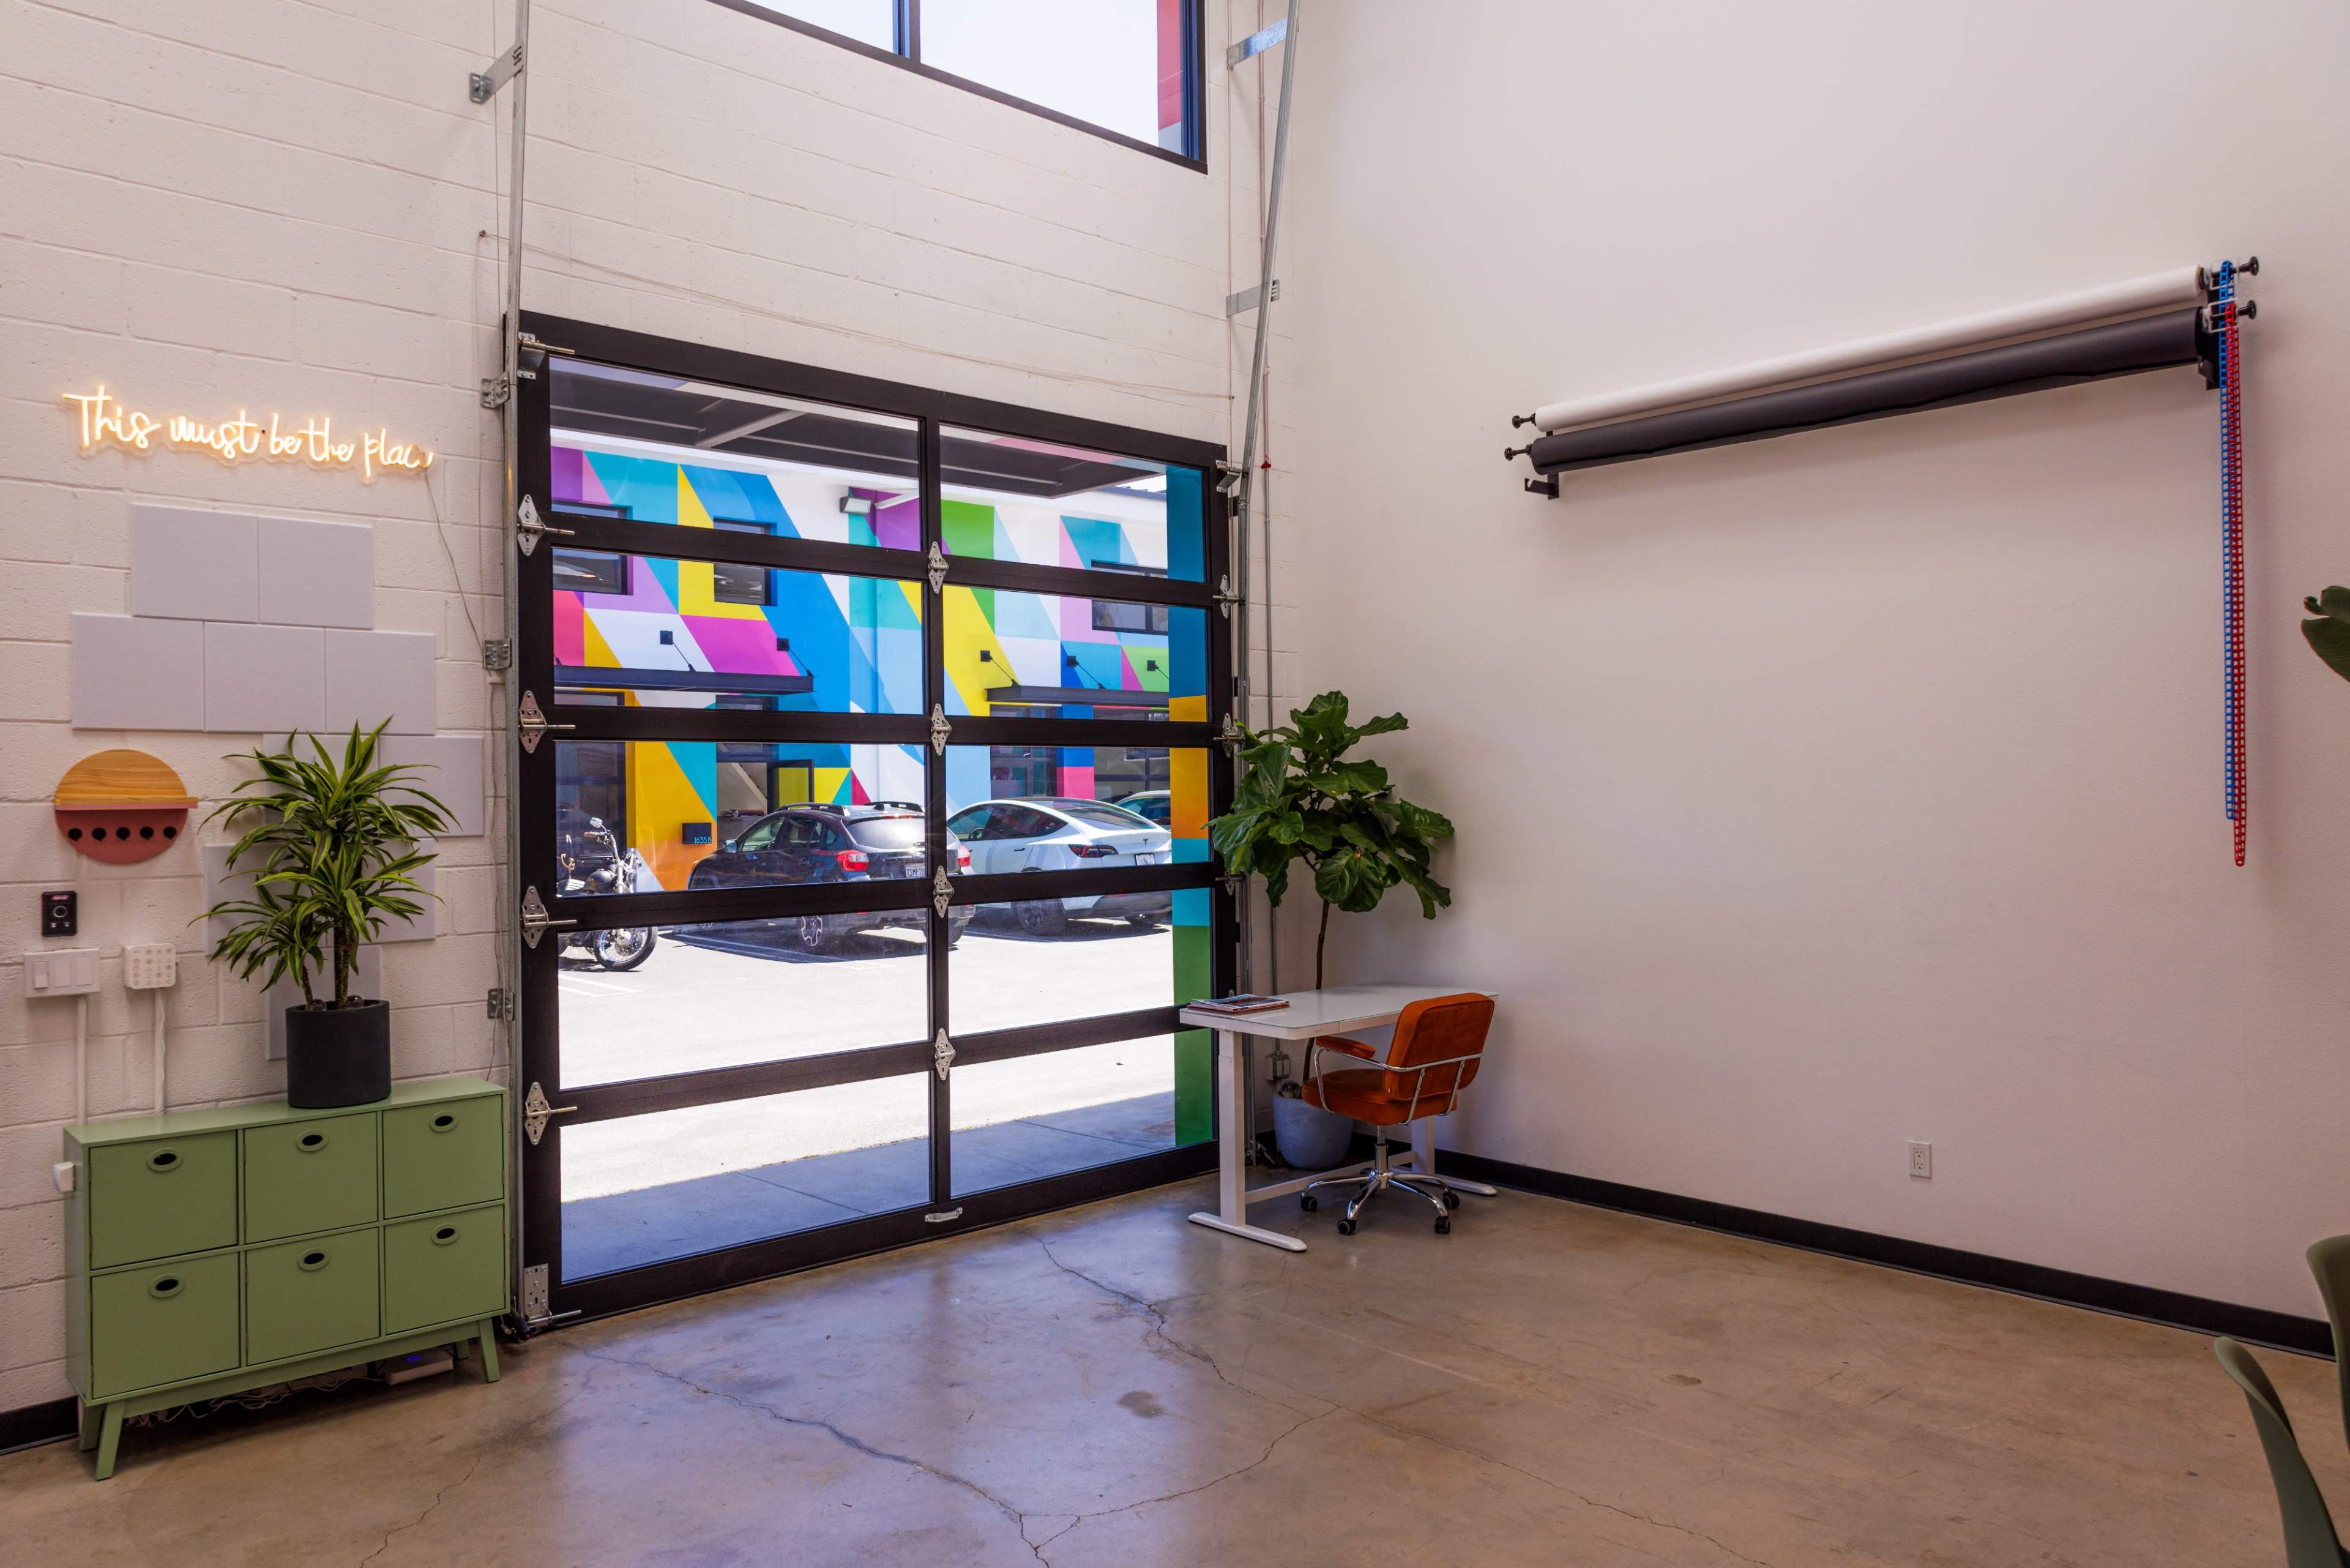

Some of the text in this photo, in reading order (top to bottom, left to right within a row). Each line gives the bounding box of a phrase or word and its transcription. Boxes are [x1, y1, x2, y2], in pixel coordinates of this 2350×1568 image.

[62, 384, 162, 449] This
[169, 409, 260, 459] must
[269, 412, 303, 455] be
[297, 416, 356, 462] the
